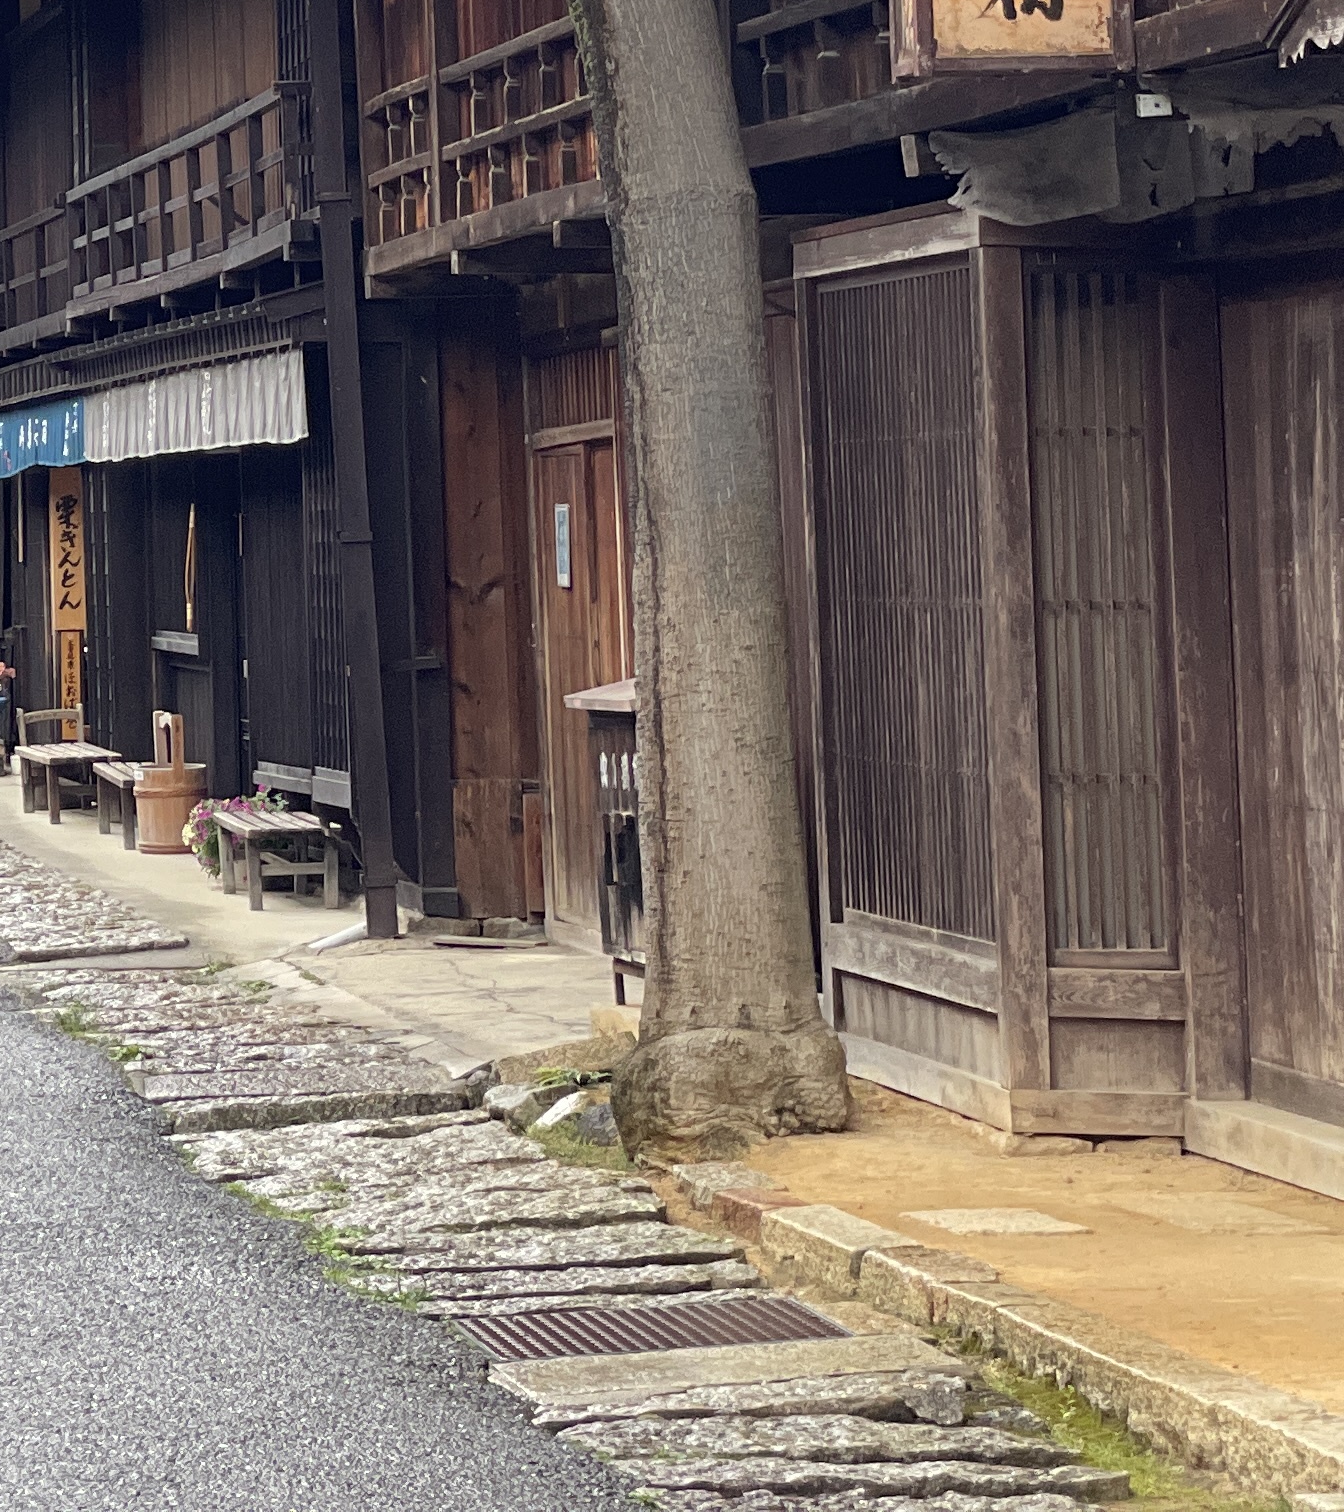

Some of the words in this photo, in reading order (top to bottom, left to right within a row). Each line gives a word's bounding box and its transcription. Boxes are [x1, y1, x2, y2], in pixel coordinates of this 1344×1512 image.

[55, 494, 83, 610] 栗きんとん
